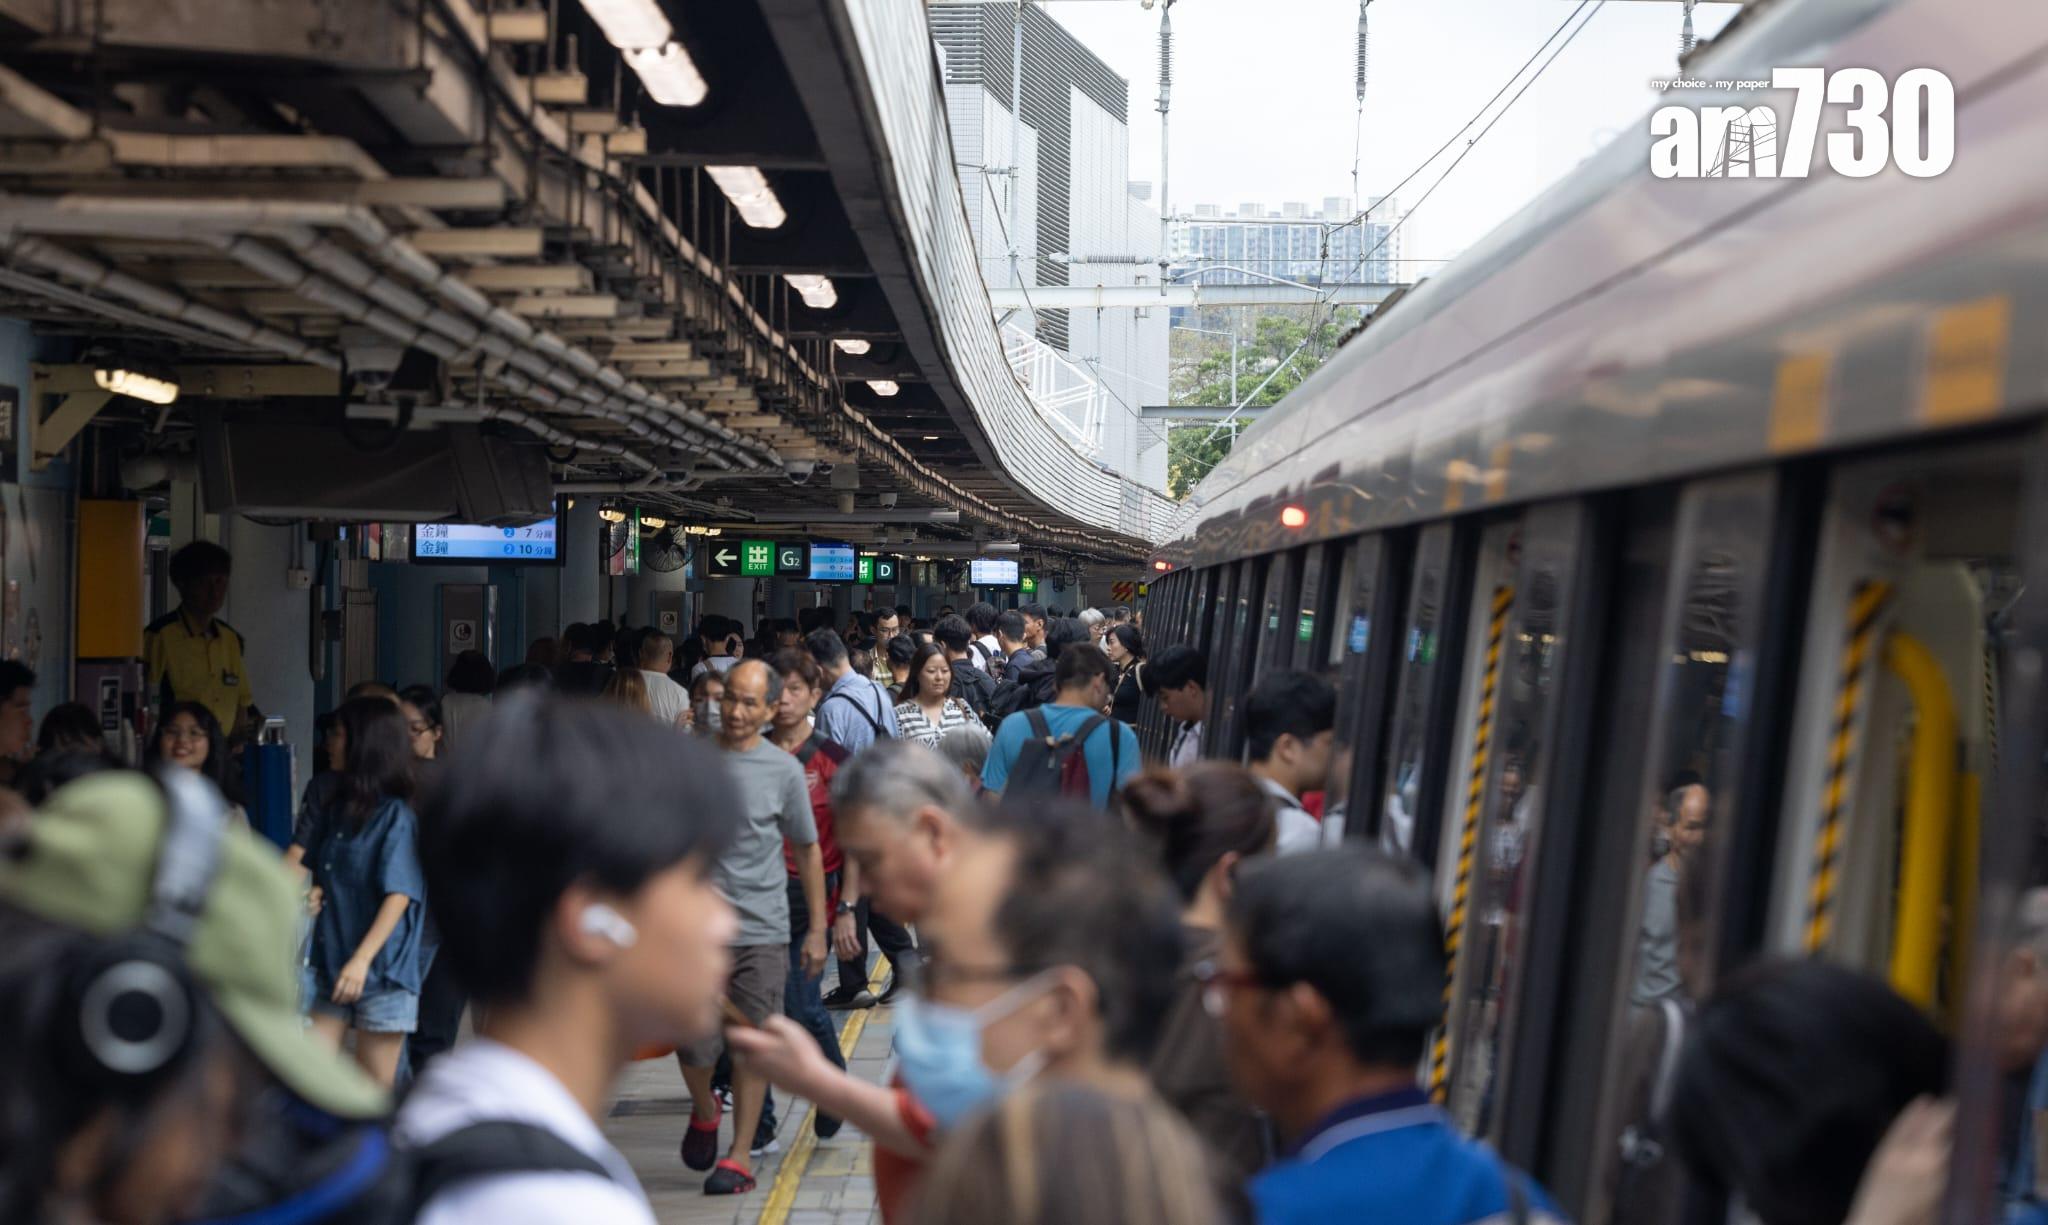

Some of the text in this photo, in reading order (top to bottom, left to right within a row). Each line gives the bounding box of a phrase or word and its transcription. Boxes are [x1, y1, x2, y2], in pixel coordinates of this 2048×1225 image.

[525, 528, 532, 537] 7
[421, 540, 448, 555] 金鐘
[520, 544, 532, 554] 10
[880, 564, 891, 577] D
